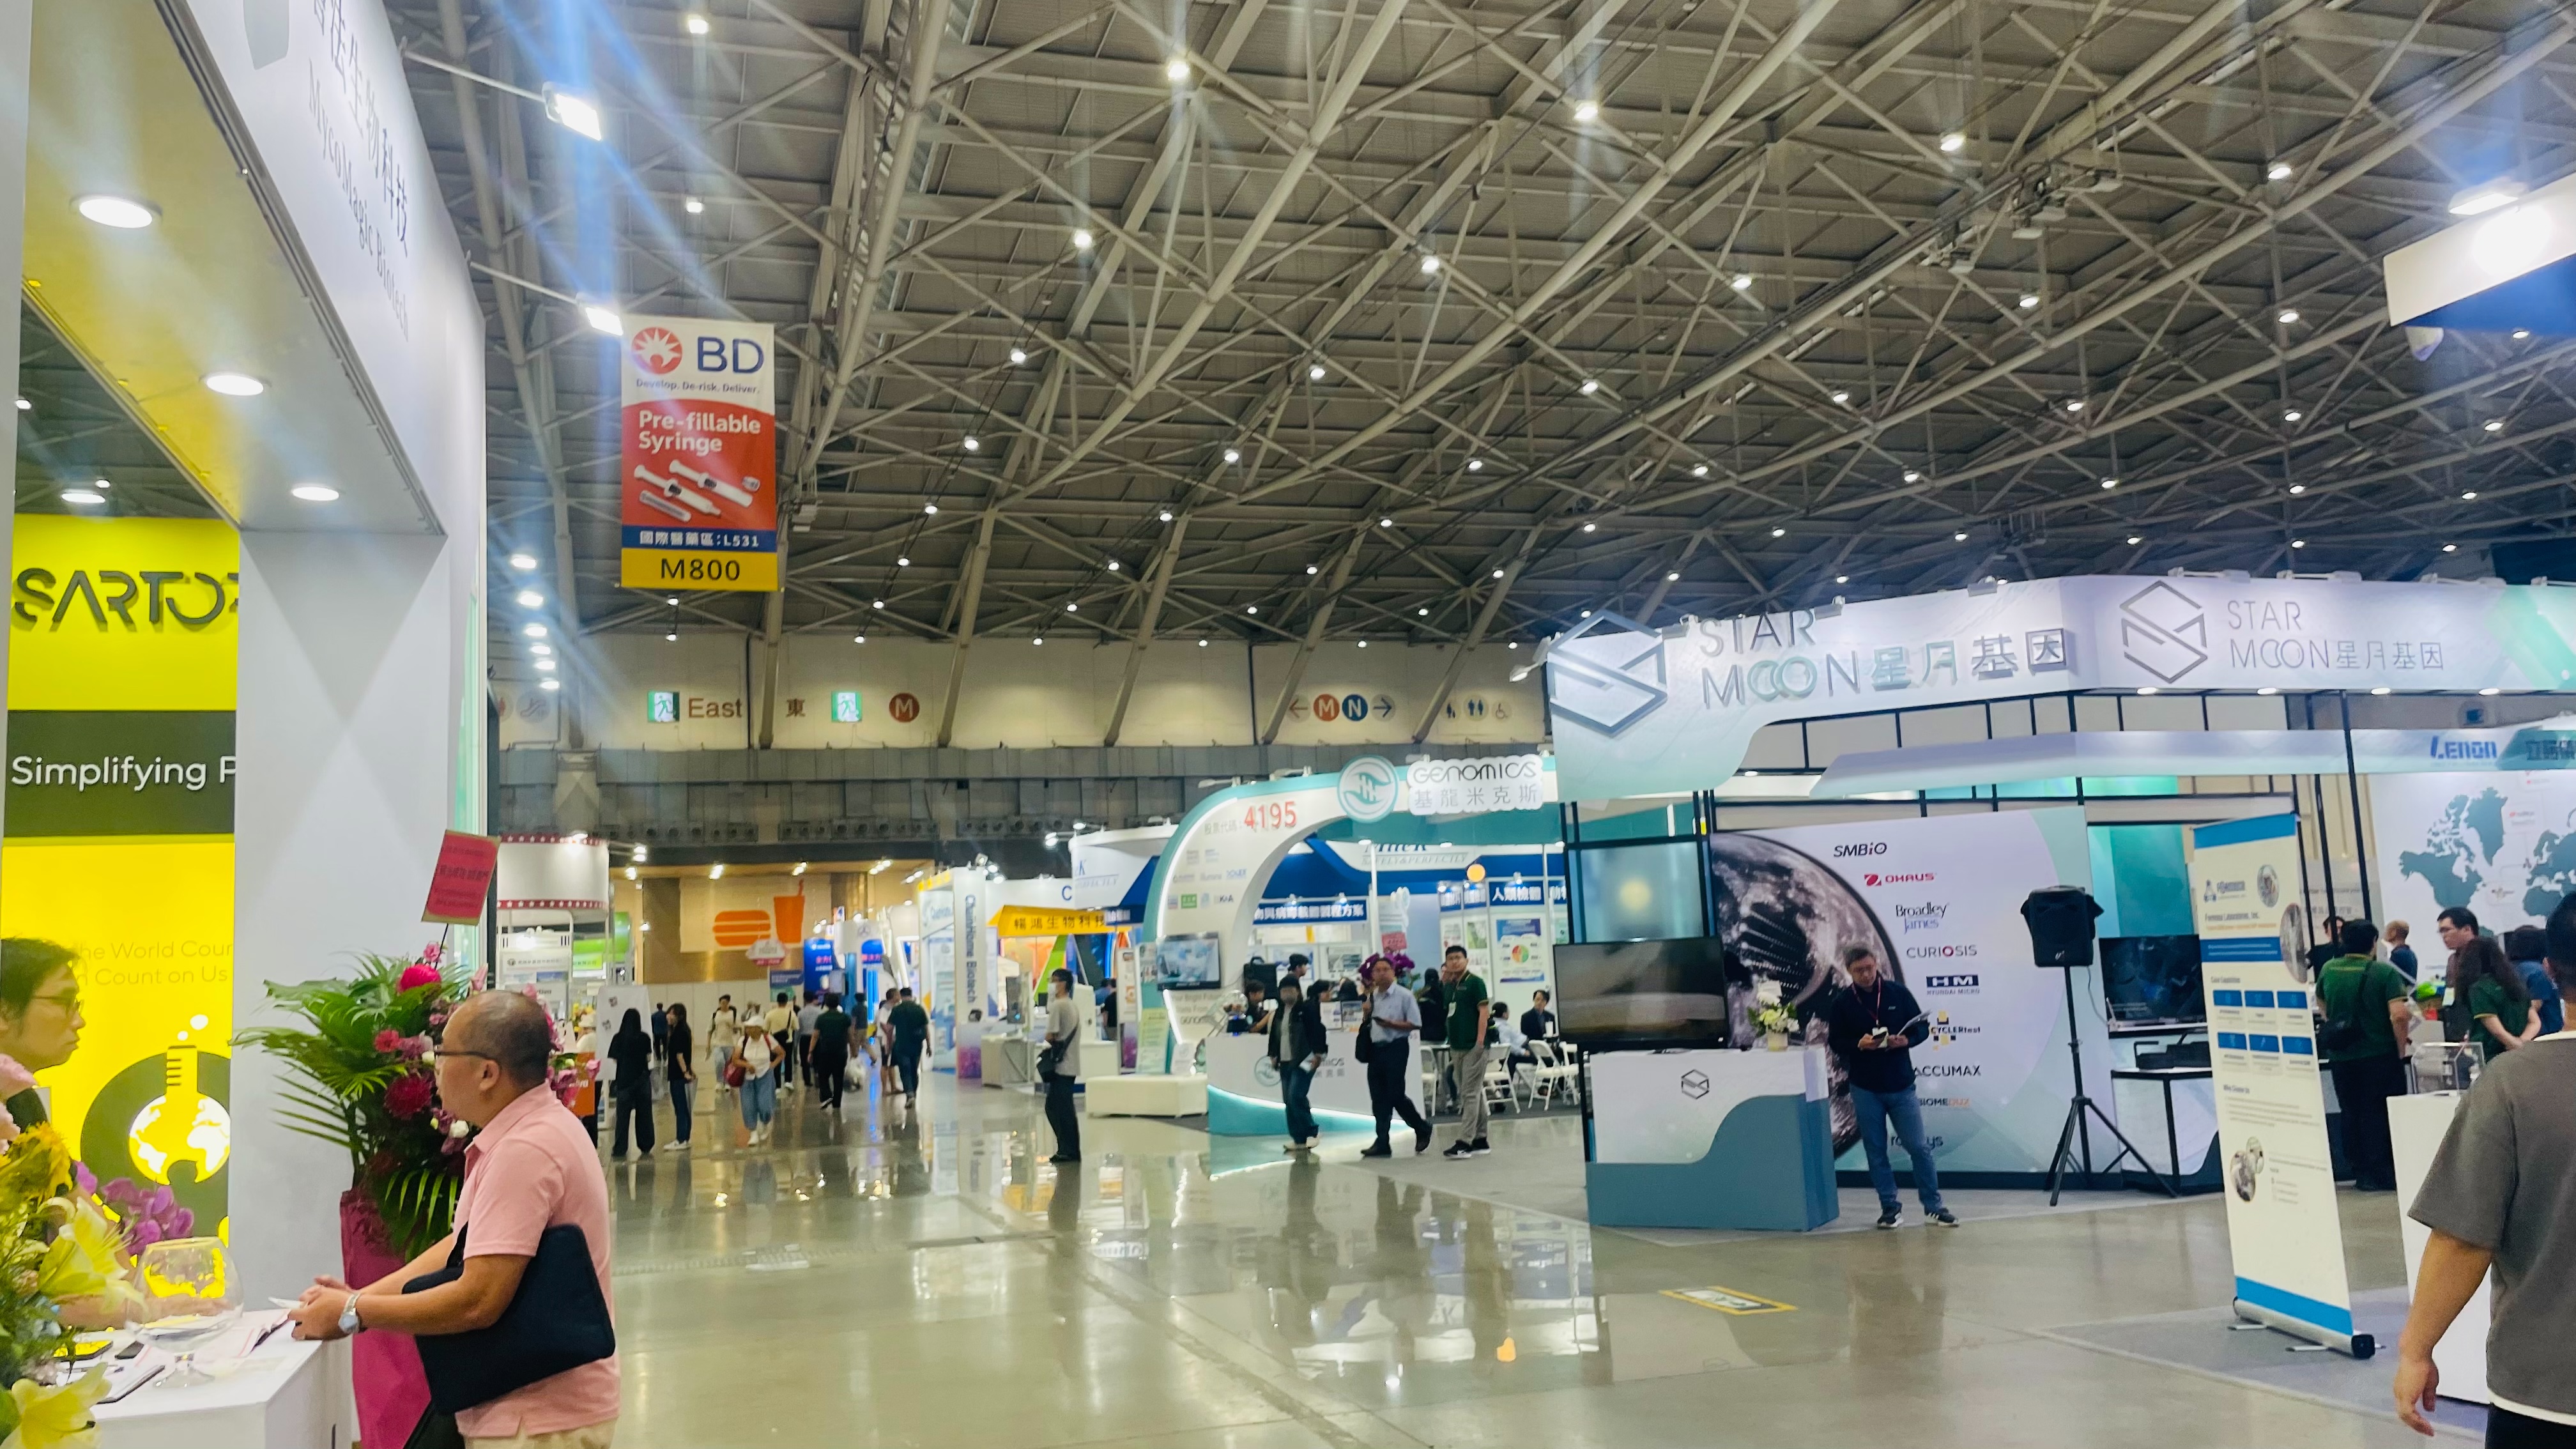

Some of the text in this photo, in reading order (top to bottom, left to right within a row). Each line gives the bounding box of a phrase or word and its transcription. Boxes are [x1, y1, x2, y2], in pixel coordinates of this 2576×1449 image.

[309, 56, 408, 343] MycoMagic Biotech
[698, 337, 764, 374] BD
[639, 410, 761, 434] Pre-fillable
[639, 431, 723, 456] Syringe
[661, 558, 740, 581] M800
[2228, 600, 2301, 631] STAR
[1699, 608, 1815, 657] STAR
[2230, 638, 2444, 671] MOON 星月基因
[1701, 628, 2067, 709] MOON 星月基因
[688, 698, 742, 719] East
[786, 699, 806, 719] 東
[895, 698, 913, 718] M
[1317, 698, 1335, 717] M
[12, 756, 206, 792] Simplifying
[1414, 783, 1538, 809] 基龍米克斯
[1244, 801, 1297, 829] 4195
[1885, 873, 1935, 884] OHAUS
[1896, 901, 1948, 918] Broadley
[1904, 918, 1940, 935] James
[111, 940, 174, 959] World
[1906, 945, 1977, 958] CURIOSIS
[95, 969, 162, 986] Count
[168, 969, 194, 984] on
[202, 967, 227, 983] Us
[1932, 976, 1974, 986] HM
[1913, 1065, 1981, 1077] ACCUMAX
